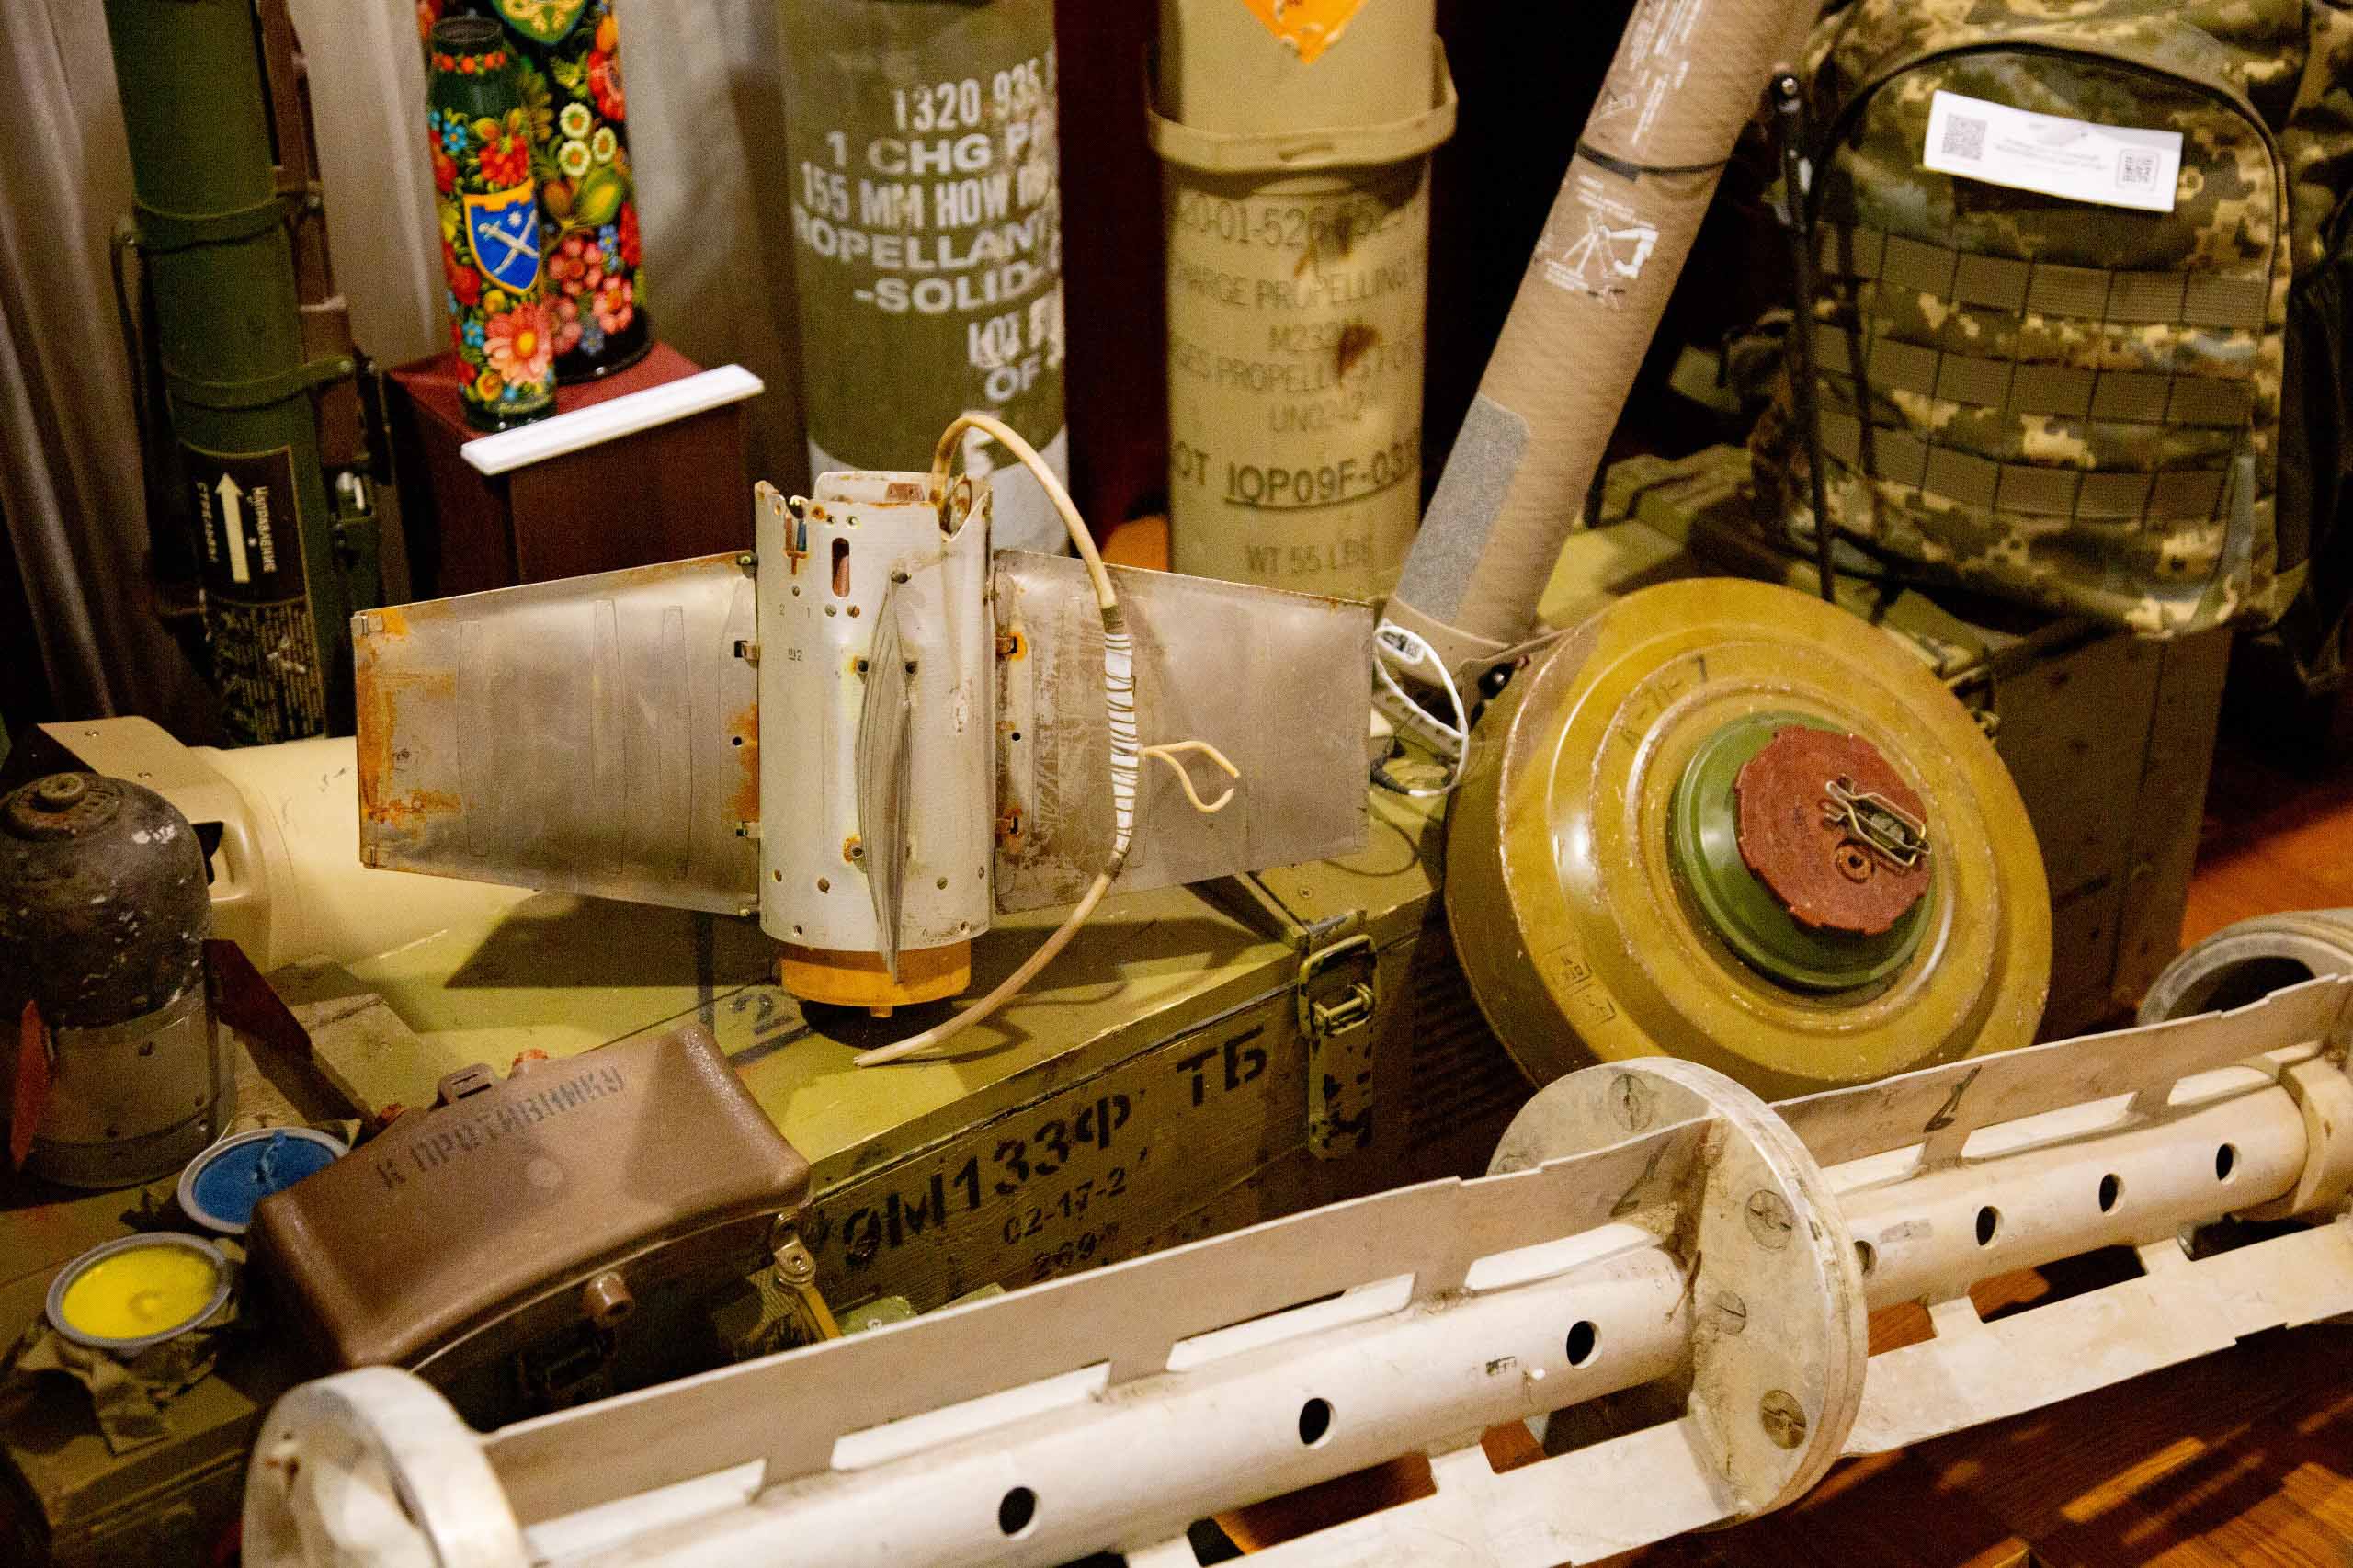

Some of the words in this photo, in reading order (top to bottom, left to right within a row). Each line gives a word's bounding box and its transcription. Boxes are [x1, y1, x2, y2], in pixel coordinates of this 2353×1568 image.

[893, 77, 981, 132] 1320
[826, 131, 847, 168] 1
[867, 133, 993, 176] CHG
[801, 161, 849, 222] 155
[858, 178, 926, 231] MM
[934, 170, 1011, 229] HOW
[1176, 1024, 1268, 1108] ТБ
[376, 1160, 406, 1191] К
